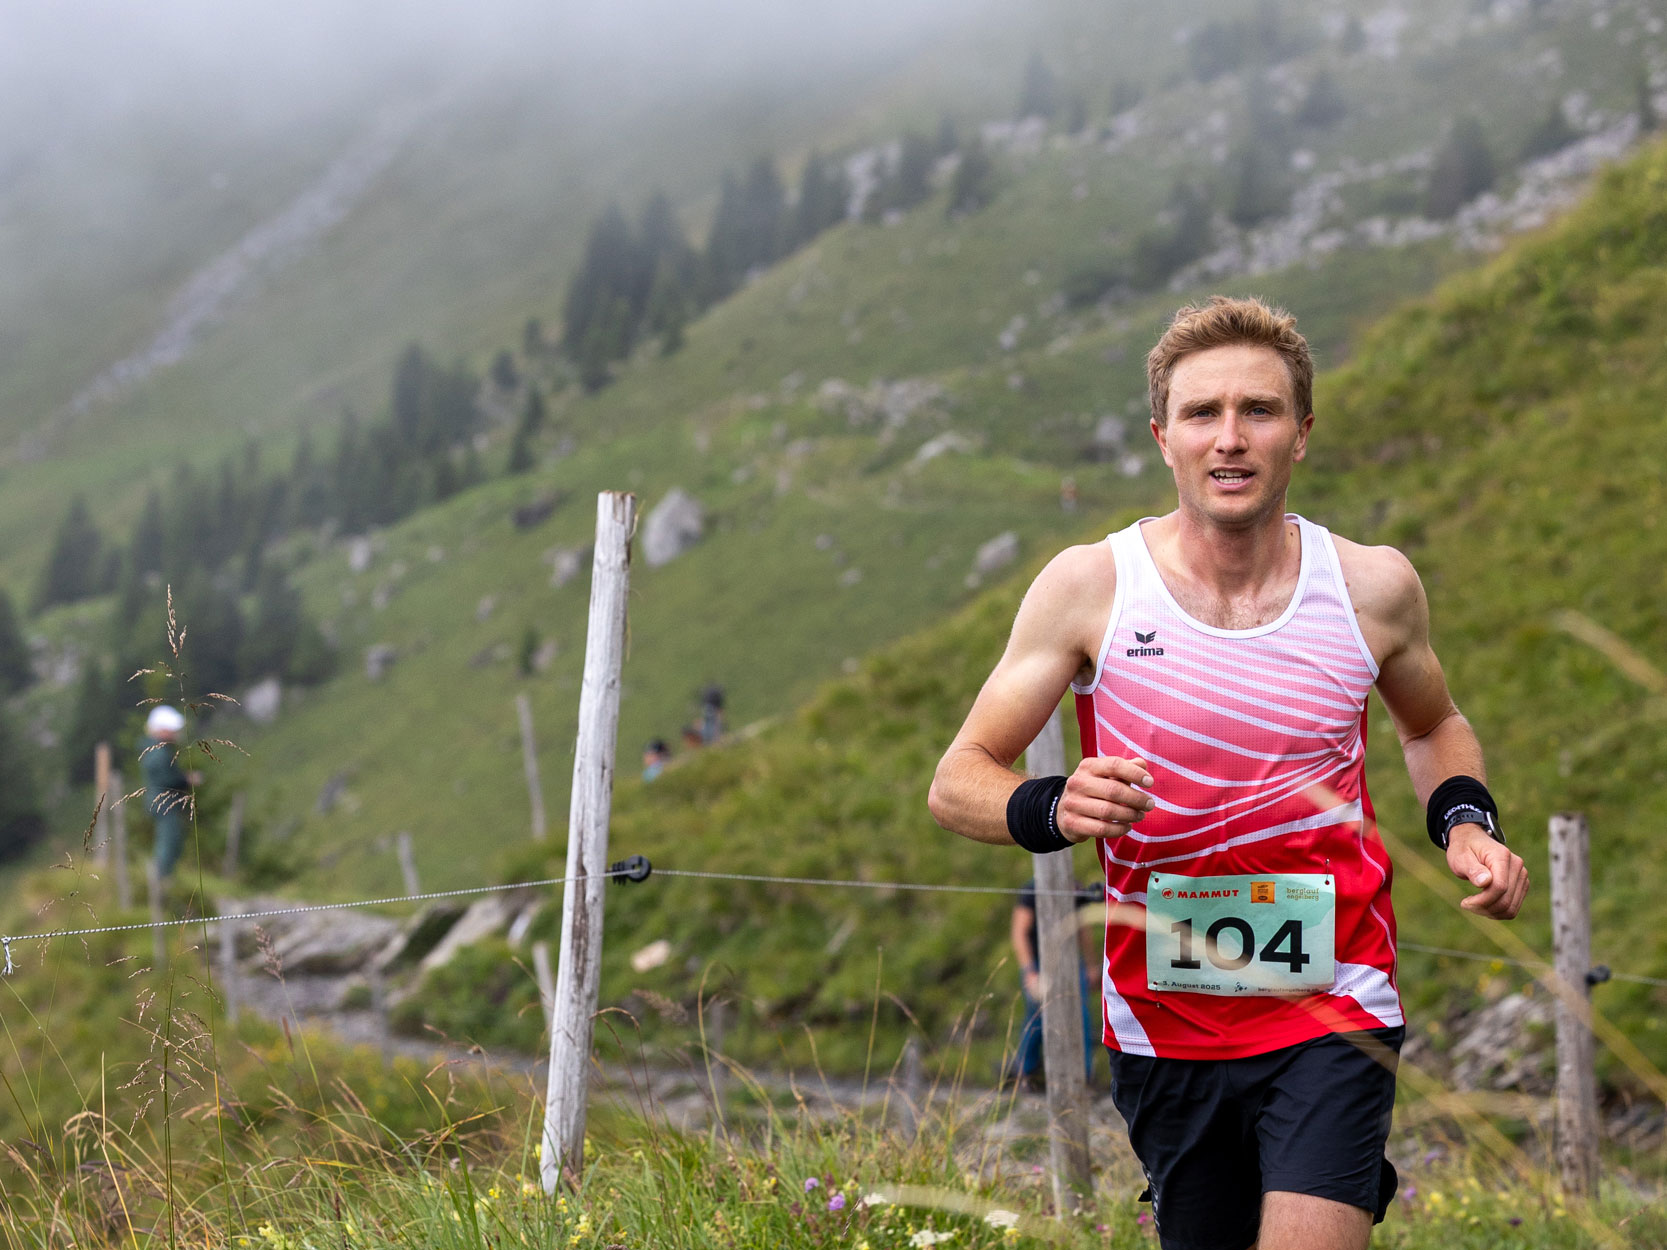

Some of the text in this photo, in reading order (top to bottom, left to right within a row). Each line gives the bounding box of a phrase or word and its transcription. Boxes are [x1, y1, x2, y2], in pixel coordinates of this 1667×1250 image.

[1126, 646, 1164, 657] erima
[1177, 889, 1240, 899] MAMMUT
[1286, 887, 1319, 895] berglauf
[1170, 916, 1310, 974] 104
[1171, 981, 1199, 989] August
[1200, 983, 1221, 991] 2025
